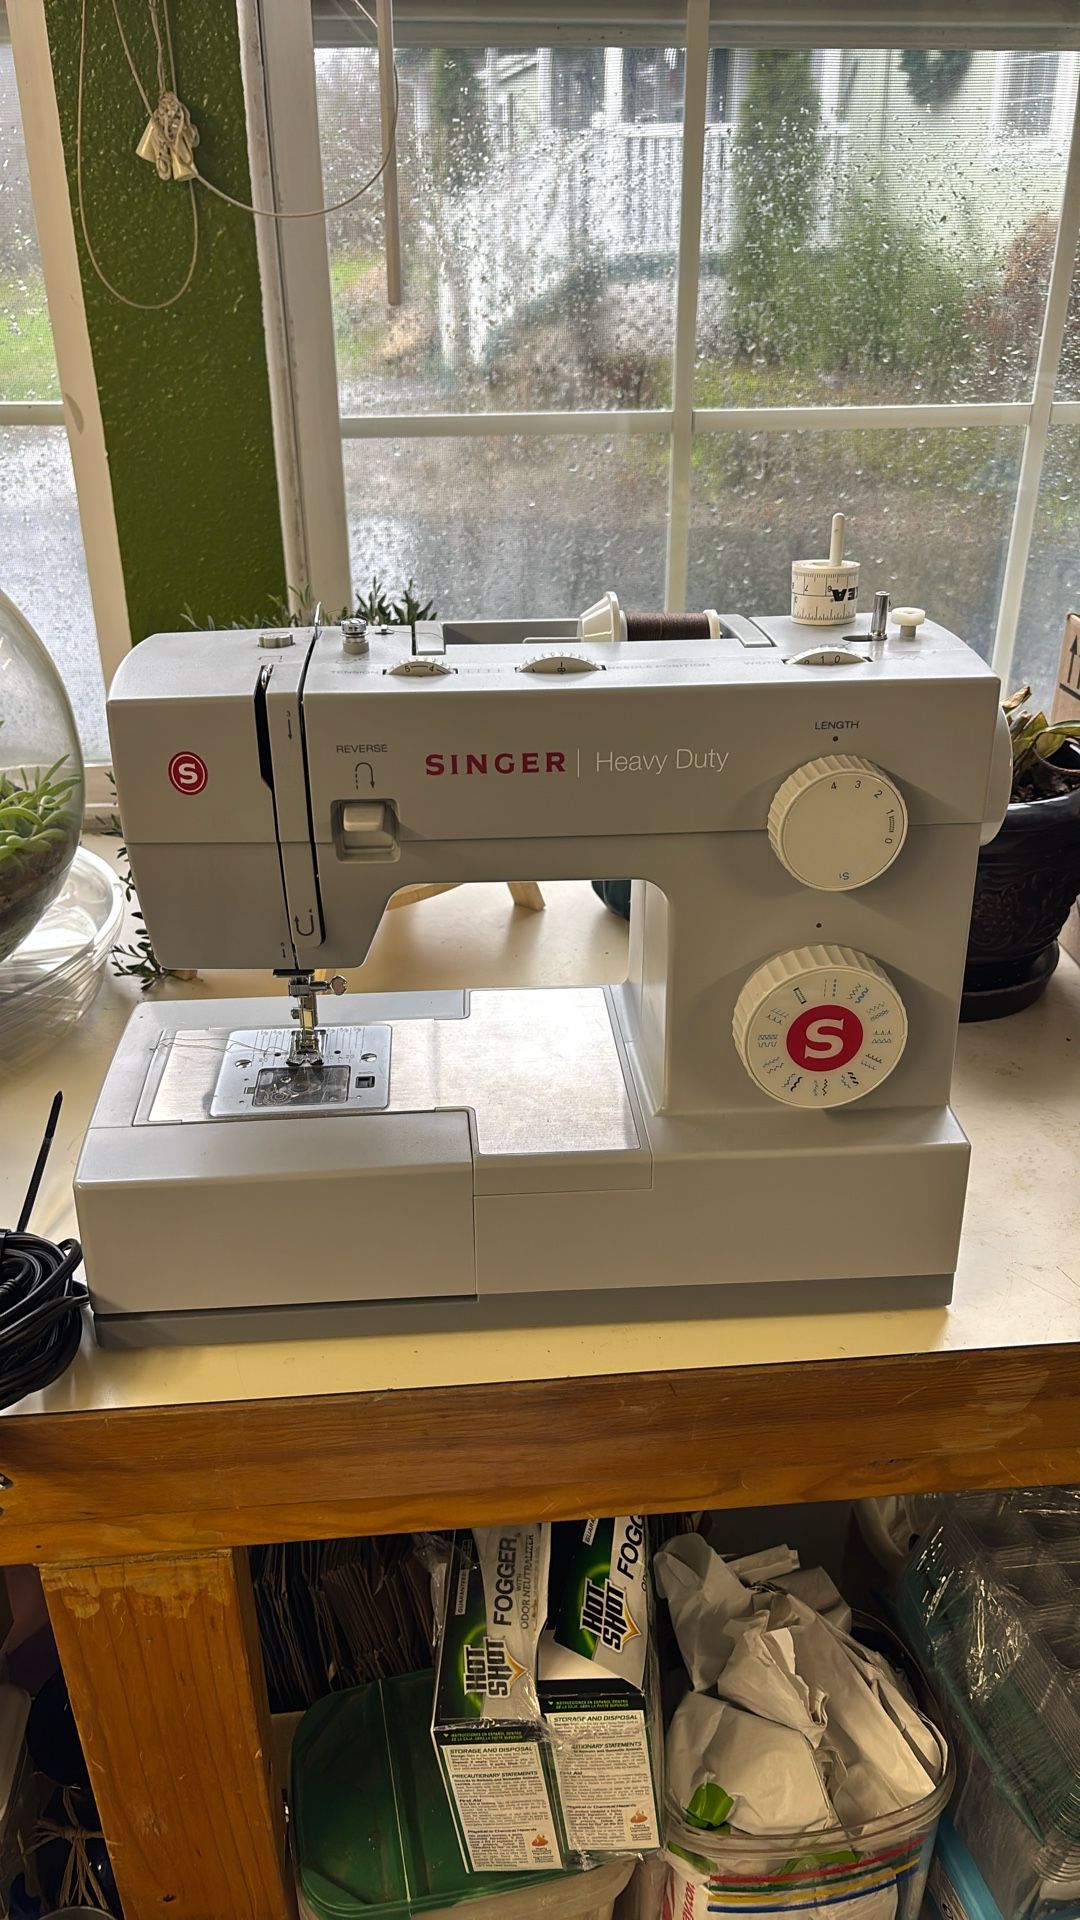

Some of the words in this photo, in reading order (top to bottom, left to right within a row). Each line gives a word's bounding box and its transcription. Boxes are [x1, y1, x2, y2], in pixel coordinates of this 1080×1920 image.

[834, 655, 841, 664] 0
[814, 720, 859, 730] LENGTH
[336, 744, 388, 753] REVERSE
[425, 752, 566, 775] SINGER
[596, 751, 668, 775] Heavy
[676, 748, 729, 773] Duty
[831, 781, 837, 790] 4
[855, 780, 861, 789] 3
[873, 790, 883, 799] 2
[804, 1018, 844, 1060] S
[493, 1537, 518, 1626] FOGGER
[521, 1600, 530, 1629] ODOR
[581, 1580, 605, 1634] HOT
[602, 1580, 630, 1651] SHOT
[466, 1646, 487, 1689] HOT
[486, 1638, 512, 1696] SHOT
